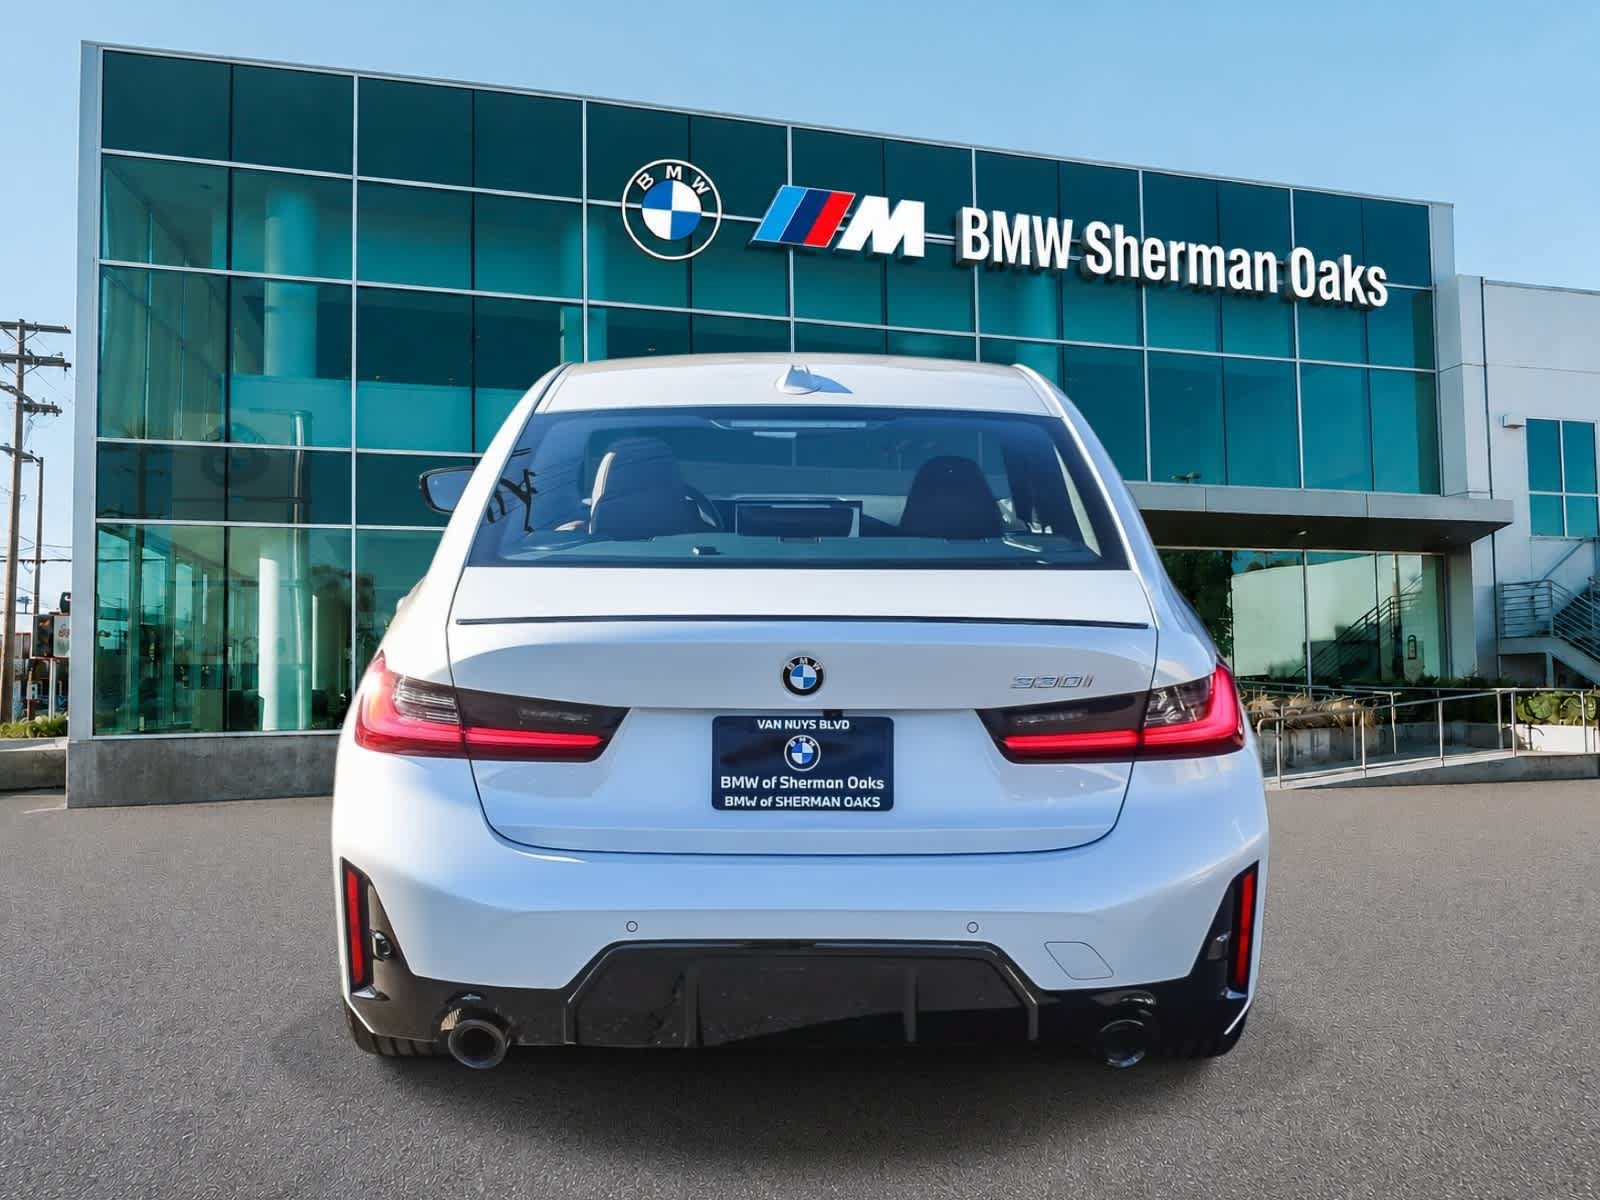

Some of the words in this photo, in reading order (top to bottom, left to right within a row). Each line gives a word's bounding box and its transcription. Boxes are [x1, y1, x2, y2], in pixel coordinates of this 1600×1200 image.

[636, 165, 711, 196] BMW
[834, 194, 925, 258] M
[960, 206, 1073, 270] BMW
[1084, 220, 1278, 293] Sherman
[1290, 246, 1389, 308] Oaks
[1010, 674, 1095, 688] 330i
[757, 719, 782, 730] VAN
[784, 719, 817, 730] NUYS
[819, 719, 850, 730] BLVD
[720, 776, 759, 789] BMW
[762, 776, 777, 789] of
[779, 776, 844, 789] Sherman
[847, 776, 885, 789] Oaks
[724, 796, 757, 807] BMW
[760, 796, 773, 807] of
[775, 796, 841, 807] SHERMAN
[844, 796, 881, 808] OAKS
